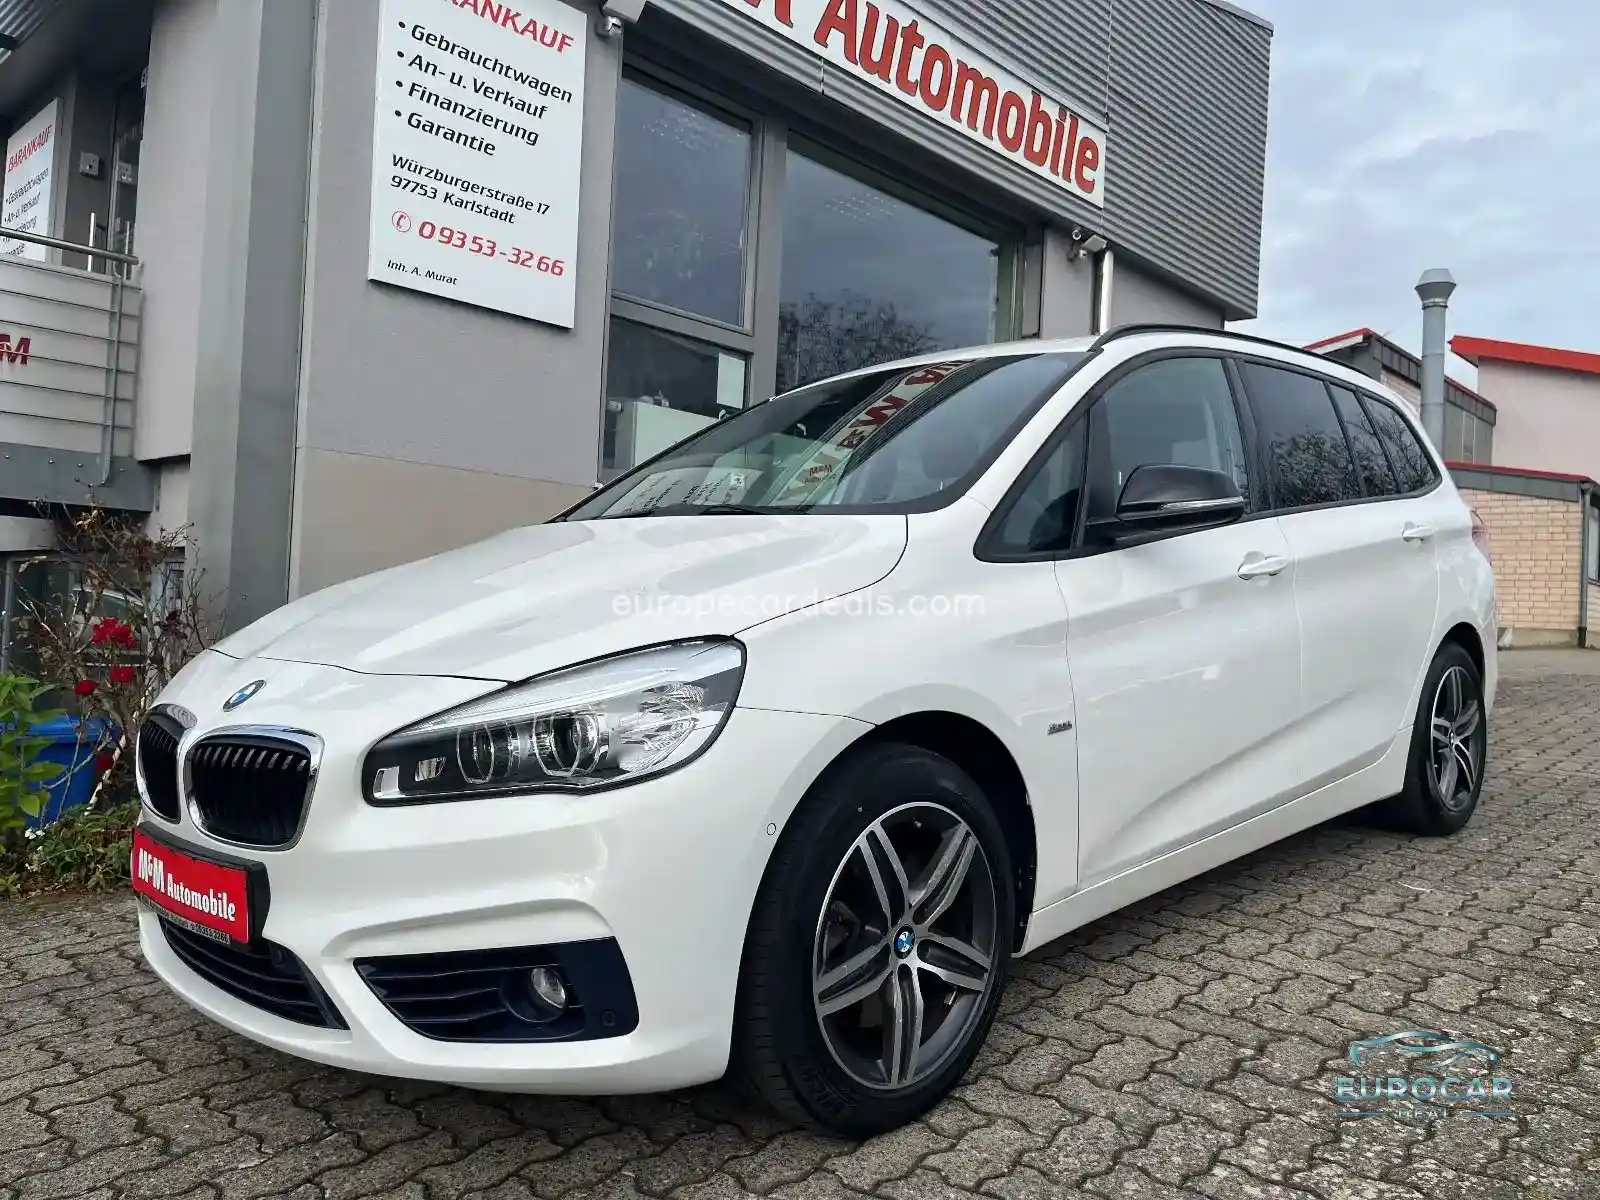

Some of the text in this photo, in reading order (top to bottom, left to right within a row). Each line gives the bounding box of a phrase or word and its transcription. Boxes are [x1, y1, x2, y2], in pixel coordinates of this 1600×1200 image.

[446, 0, 574, 53] ANKAUF
[408, 54, 548, 120] An- u. Verkauf
[411, 24, 573, 104] Gebrauchtwagen
[408, 82, 540, 147] Finanzierung
[813, 0, 1100, 194] Automobile
[407, 111, 496, 156] Garantie
[390, 175, 516, 224] 97753 Karlstadt
[392, 154, 551, 215] Würzburgerstraße 17
[387, 259, 458, 286] Inh. A. Murat
[167, 872, 236, 922] Automobile
